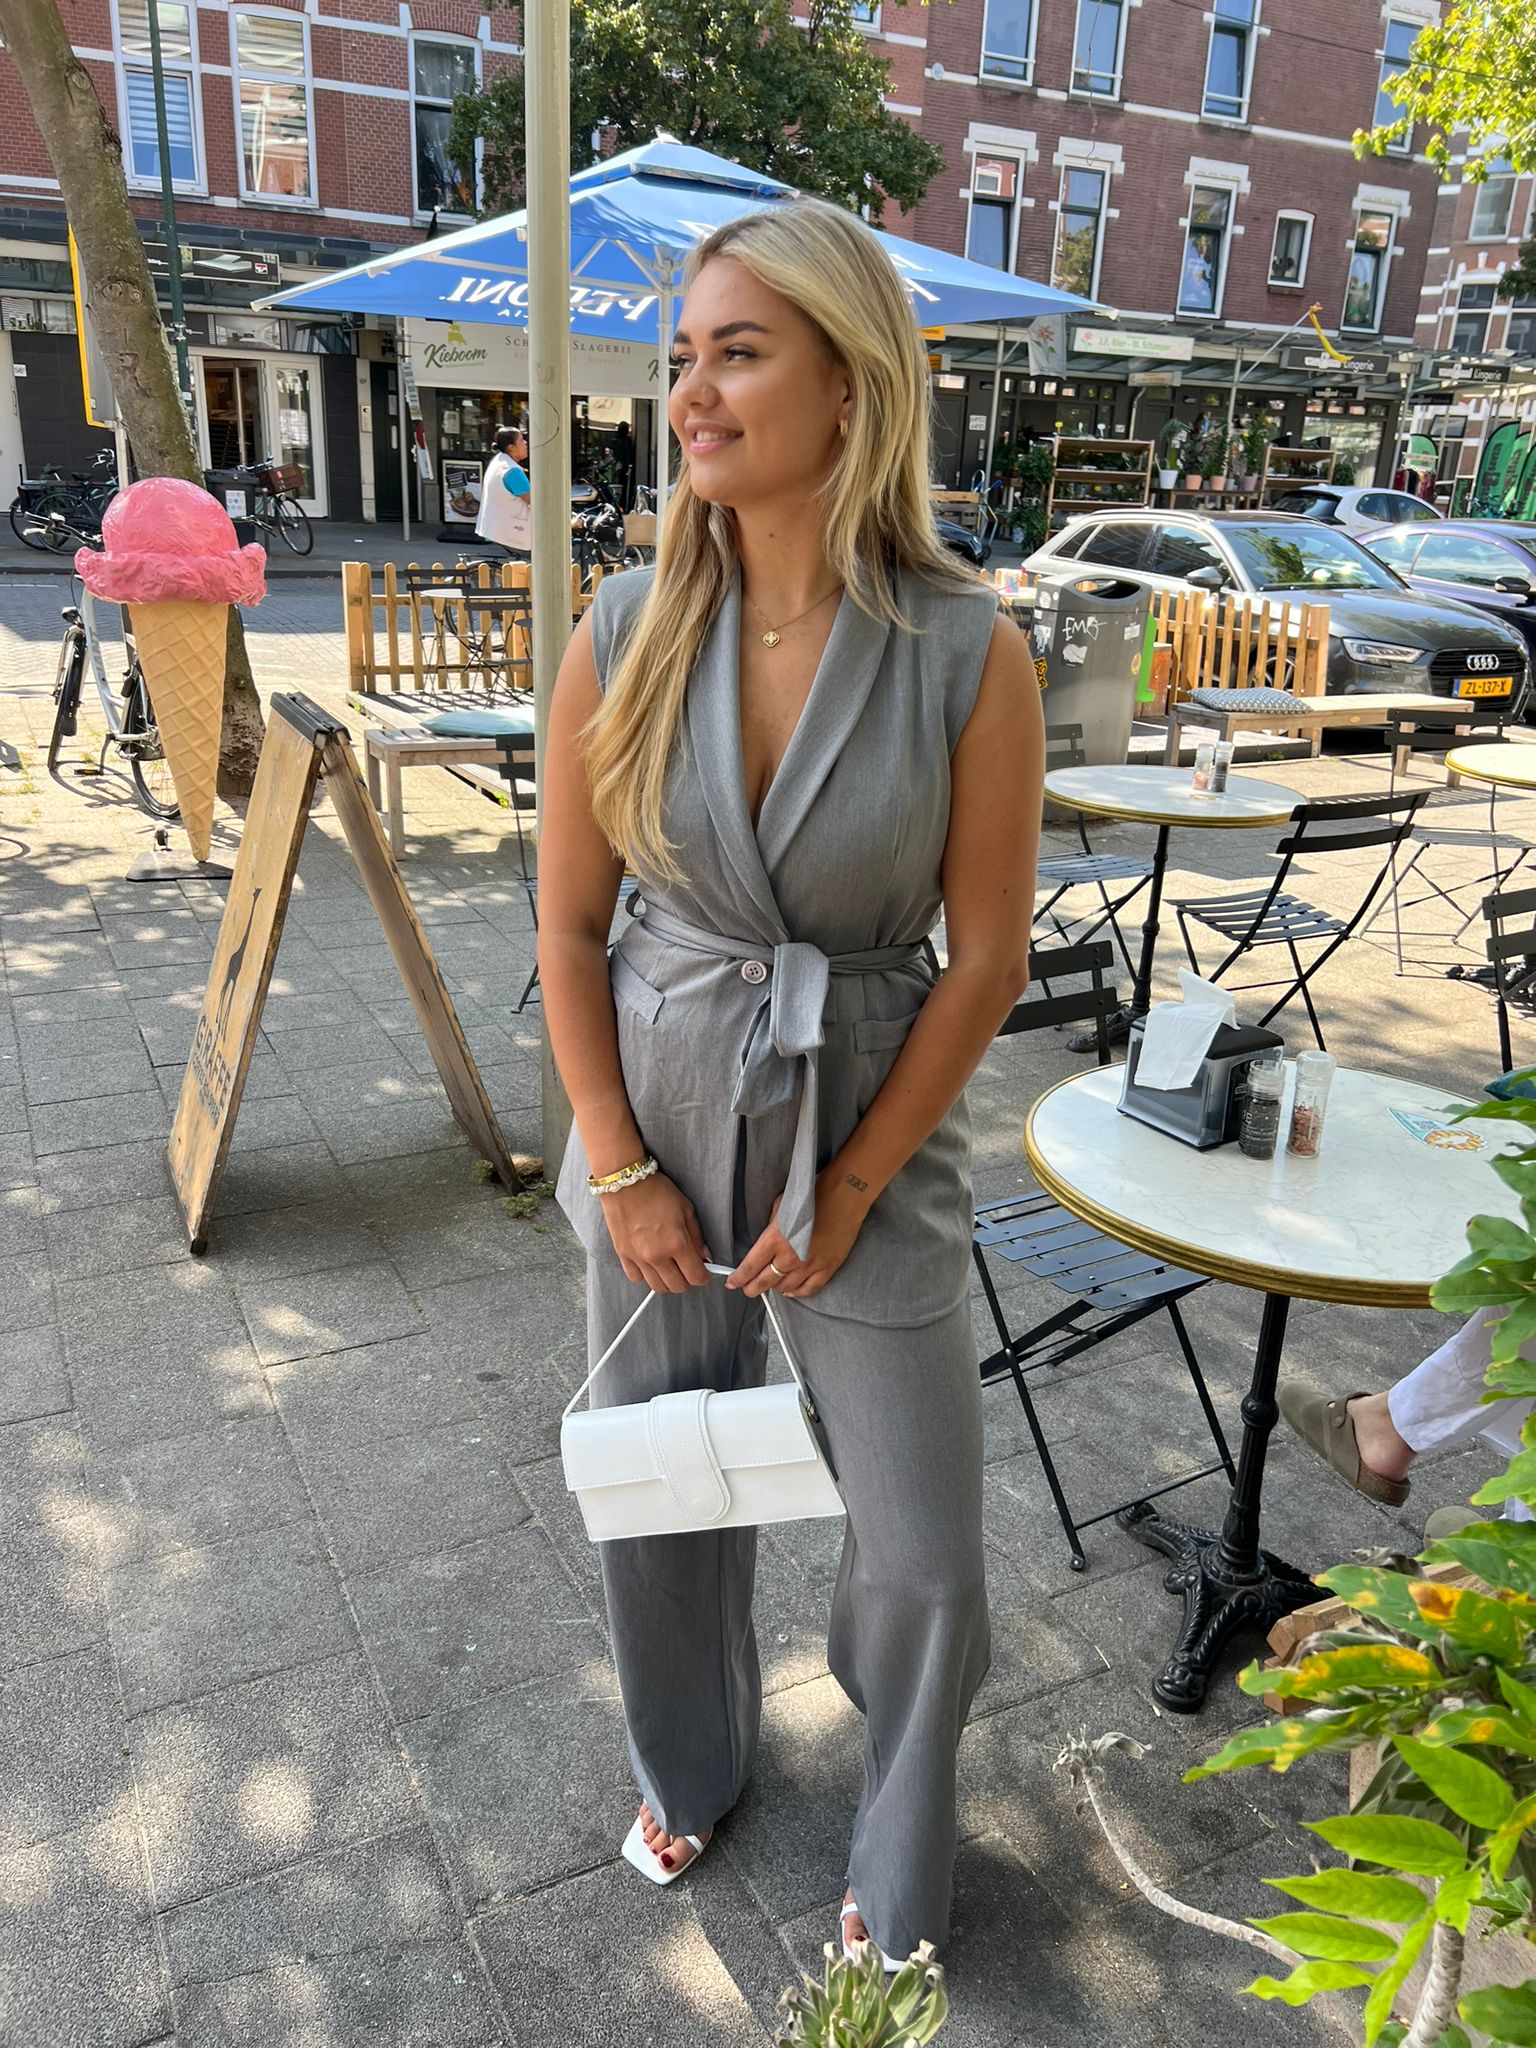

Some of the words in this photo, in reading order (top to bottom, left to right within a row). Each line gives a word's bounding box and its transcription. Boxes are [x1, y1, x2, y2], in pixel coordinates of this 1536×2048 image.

[424, 343, 488, 369] Kieboom
[1473, 368, 1502, 382] Lingerie
[1465, 680, 1507, 695] ZL-137-X
[195, 1014, 232, 1110] GIRAFFE
